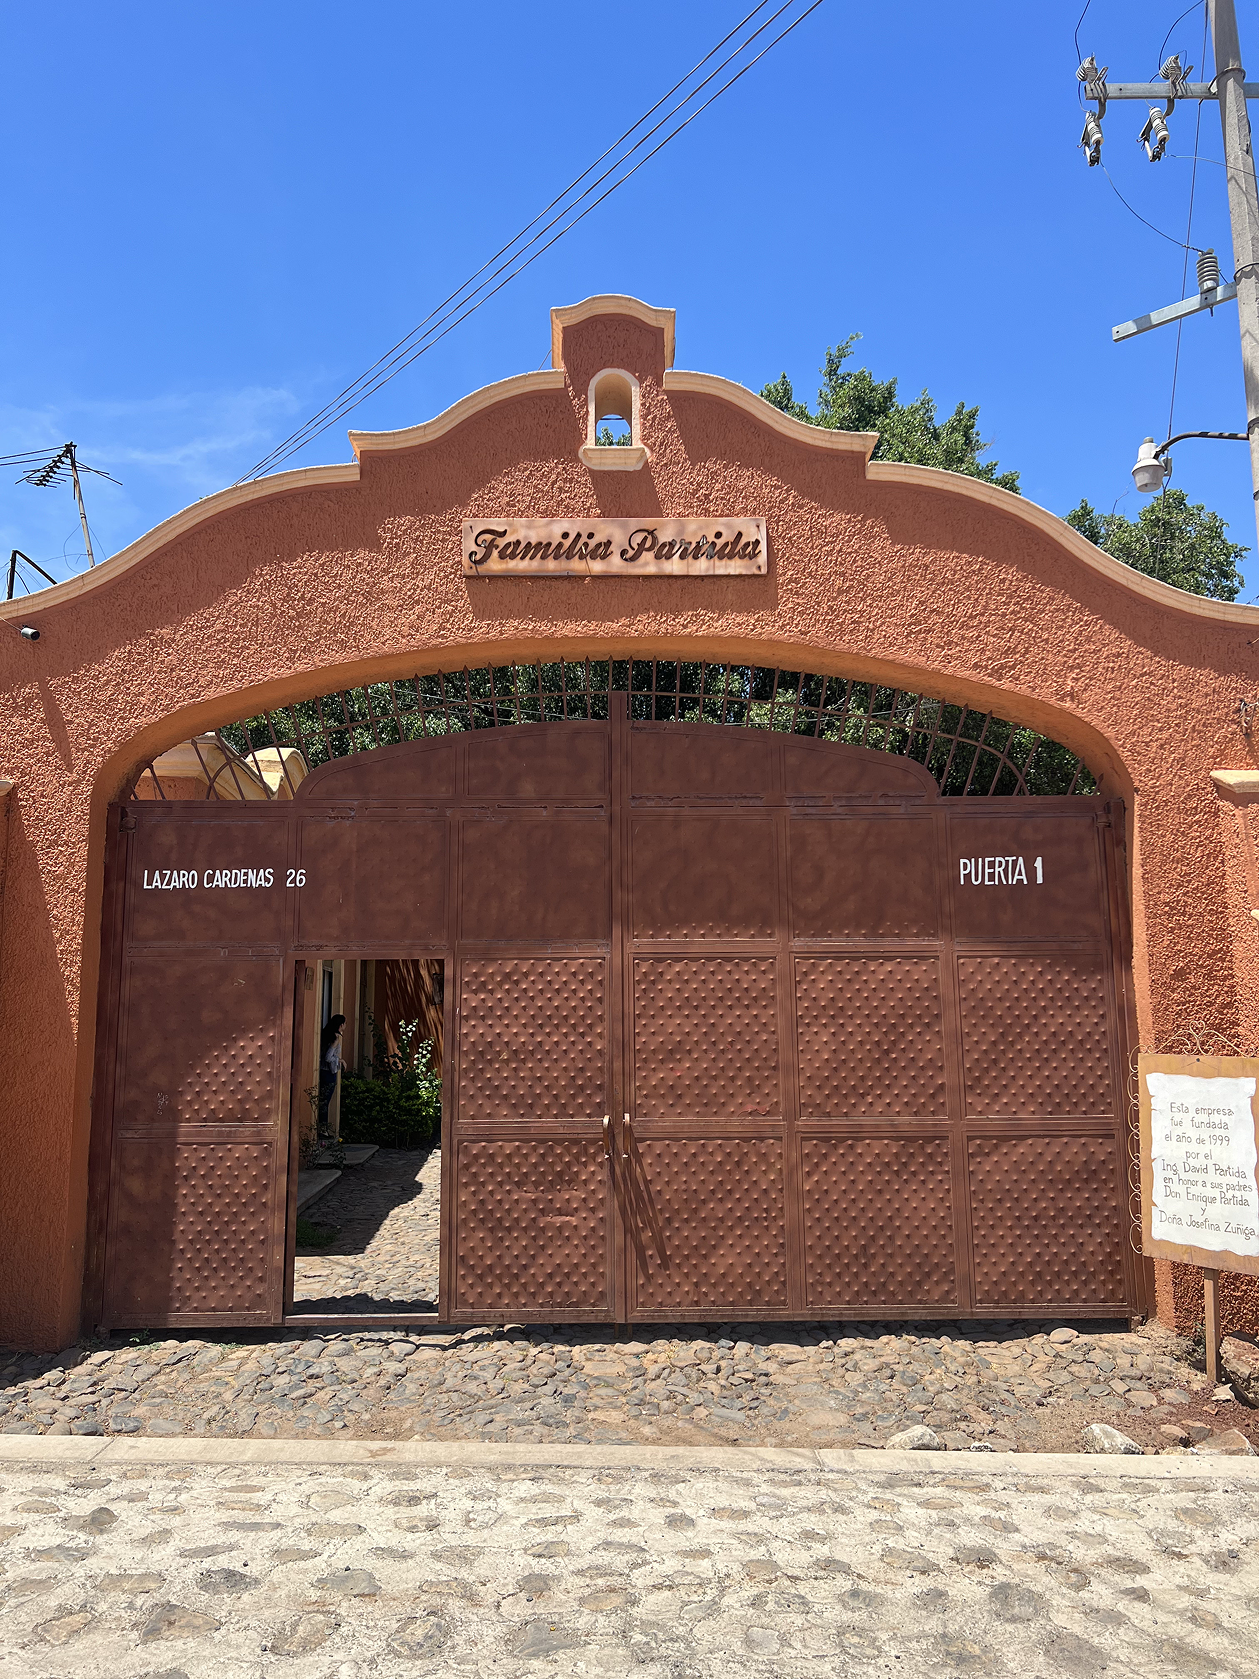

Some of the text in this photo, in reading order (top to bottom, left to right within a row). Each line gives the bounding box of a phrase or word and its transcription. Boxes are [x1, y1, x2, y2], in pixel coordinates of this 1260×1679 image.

[469, 527, 761, 565] Familia Partida
[143, 868, 307, 891] LAZARO CARDENAS 26
[959, 856, 1043, 885] PUERTA 1
[1170, 1102, 1235, 1118] Esta empresa
[1170, 1115, 1230, 1131] fué fundada
[1164, 1130, 1231, 1147] el año de 1999
[1185, 1149, 1213, 1162] por el
[1182, 1161, 1209, 1174] David
[1212, 1163, 1248, 1180] Partida
[1163, 1176, 1174, 1185] en
[1177, 1173, 1200, 1187] honor
[1201, 1180, 1207, 1188] a
[1226, 1180, 1253, 1193] padres
[1163, 1184, 1250, 1207] Don Enrique Partida
[1159, 1209, 1184, 1227] Doña
[1185, 1214, 1221, 1232] Josefina
[1200, 1207, 1207, 1216] y
